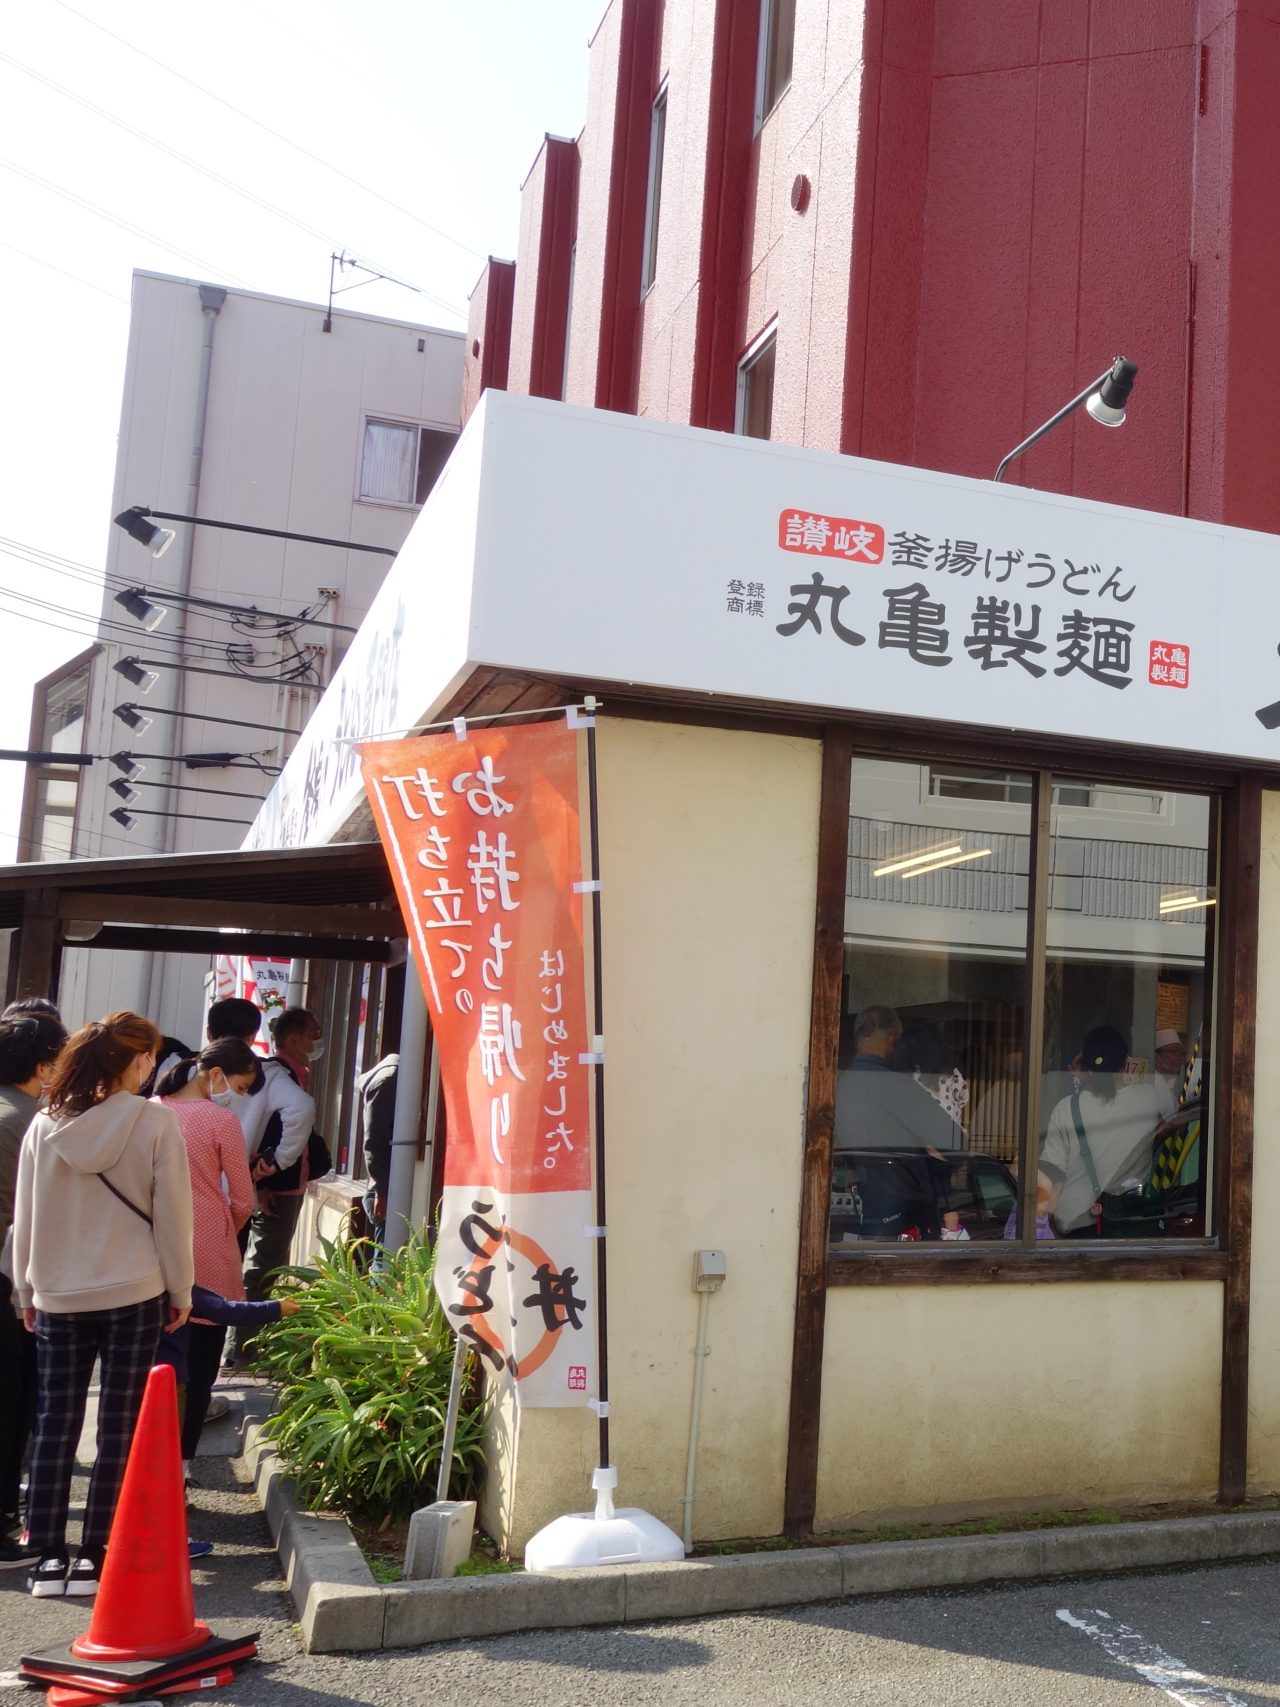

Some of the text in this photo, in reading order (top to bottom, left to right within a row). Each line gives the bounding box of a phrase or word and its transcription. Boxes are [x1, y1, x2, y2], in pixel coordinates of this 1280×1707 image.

[785, 513, 1137, 603] 讃岐 釜揚げうどん
[727, 579, 765, 599] 登録
[727, 597, 764, 617] 商標
[775, 571, 1136, 690] 丸亀製麺
